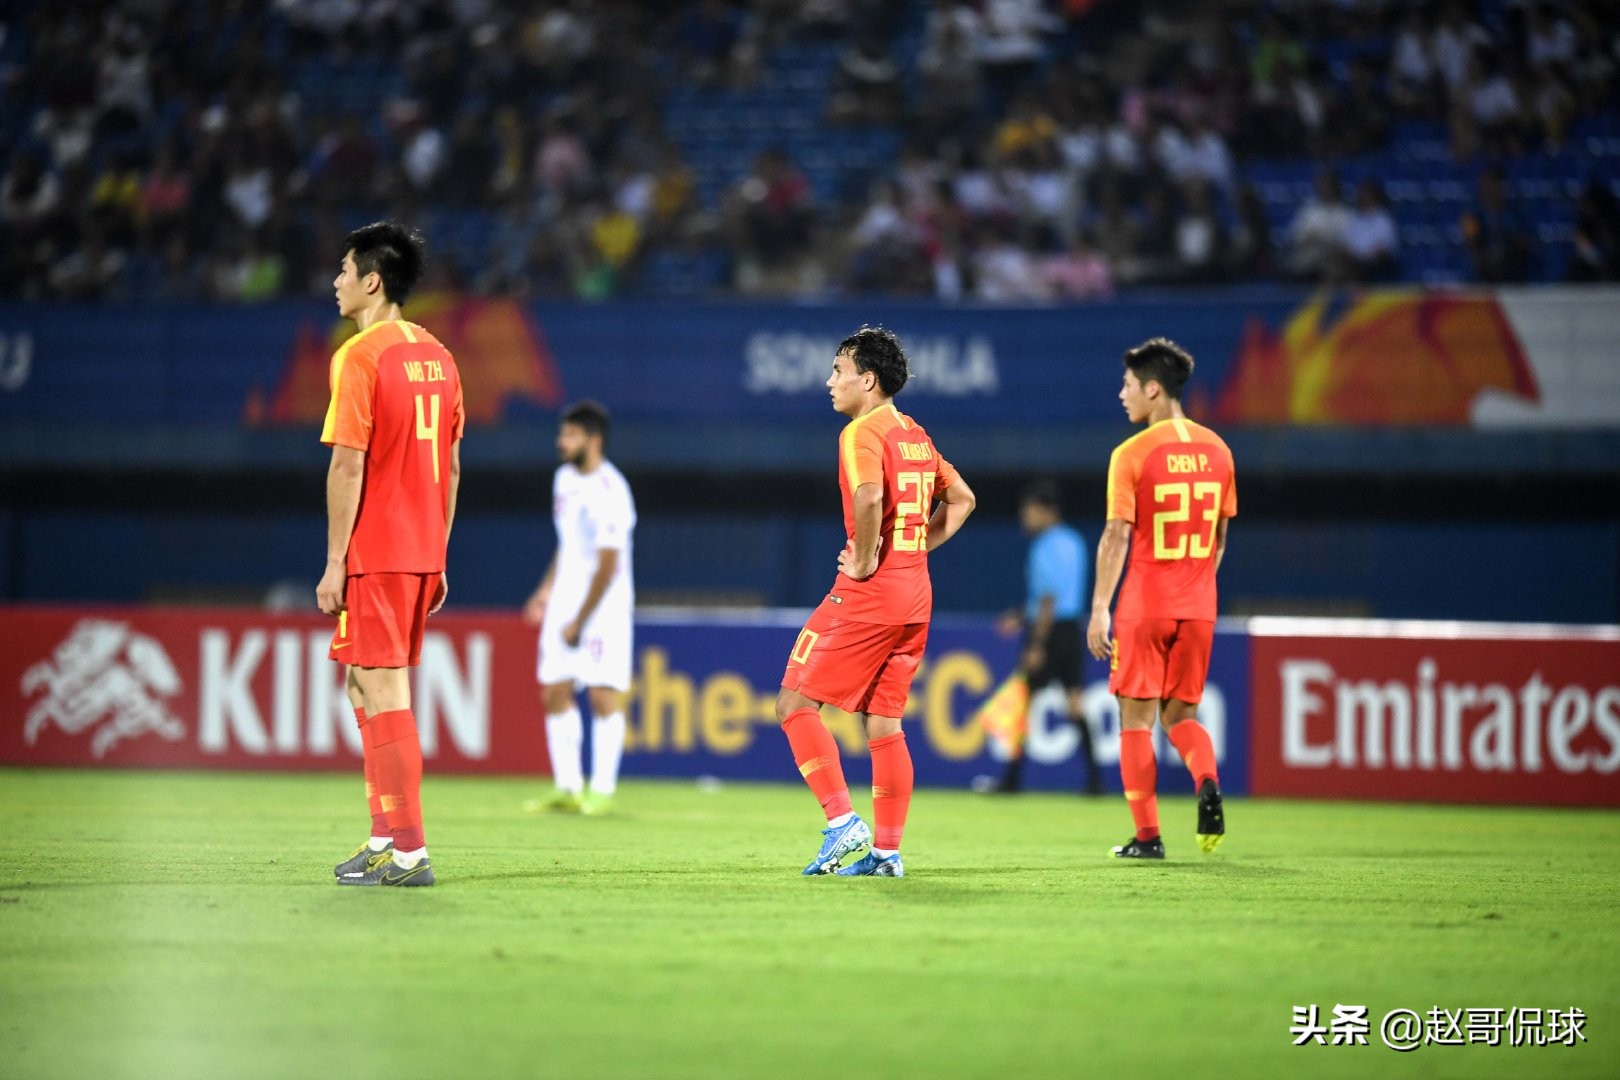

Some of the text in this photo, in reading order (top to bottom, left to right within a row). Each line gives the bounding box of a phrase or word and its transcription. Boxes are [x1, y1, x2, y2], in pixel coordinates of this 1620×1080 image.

[415, 394, 440, 484] 4
[1166, 453, 1212, 473] CHEN P.
[1154, 482, 1221, 560] 23
[200, 629, 491, 759] KIRN
[1280, 657, 1620, 774] Emirates
